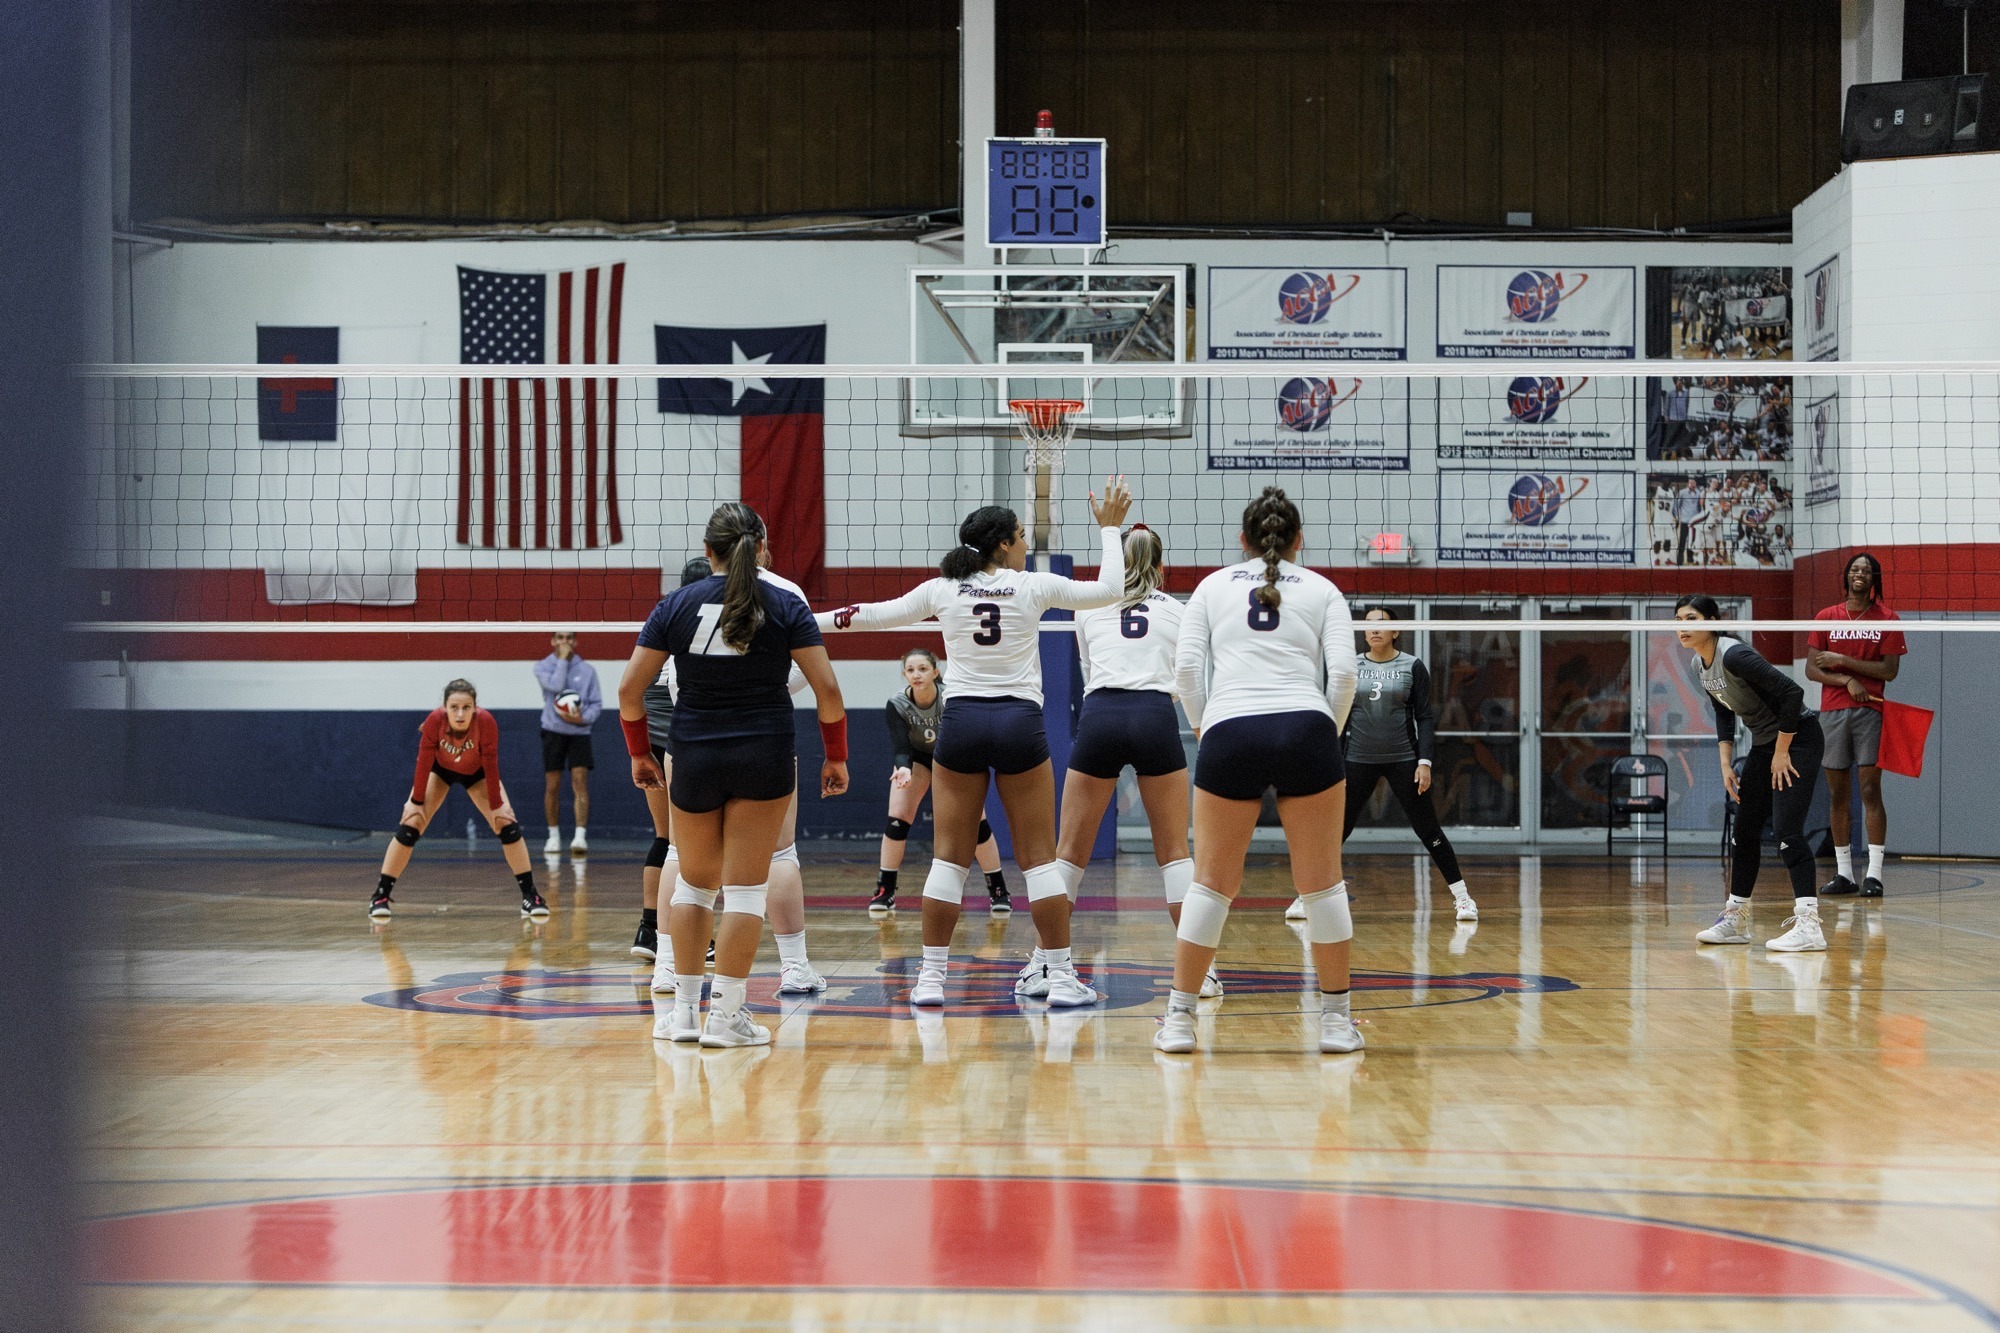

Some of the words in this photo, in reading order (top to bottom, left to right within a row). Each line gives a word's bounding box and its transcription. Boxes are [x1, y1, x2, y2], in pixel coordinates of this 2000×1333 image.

[1216, 348, 1237, 358] 2019
[1239, 348, 1264, 358] Men's
[1266, 348, 1302, 358] National
[1303, 349, 1350, 359] Basketball
[1351, 349, 1399, 360] Champions
[1467, 346, 1492, 356] Men's
[1494, 346, 1530, 357] National
[1532, 347, 1578, 357] Basketball
[1580, 347, 1627, 359] Champions
[1493, 447, 1531, 459] National
[1532, 448, 1580, 459] Basketball
[1582, 448, 1632, 460] Champions
[1265, 457, 1302, 467] National
[1304, 458, 1352, 468] Basketball
[1354, 458, 1404, 470] Champions
[1441, 549, 1462, 559] 2014
[1464, 549, 1488, 559] Men's
[1513, 550, 1549, 560] National
[1551, 551, 1595, 561] Basketball
[1597, 552, 1632, 563] Champs
[957, 583, 1017, 598] Patriots
[1247, 586, 1280, 632] 8
[972, 602, 1002, 646] 3
[1120, 603, 1149, 639] 6
[1829, 630, 1881, 640] ARKANSAS
[1357, 669, 1400, 680] RUSADERS
[1368, 681, 1383, 701] 3
[923, 728, 937, 744] 9
